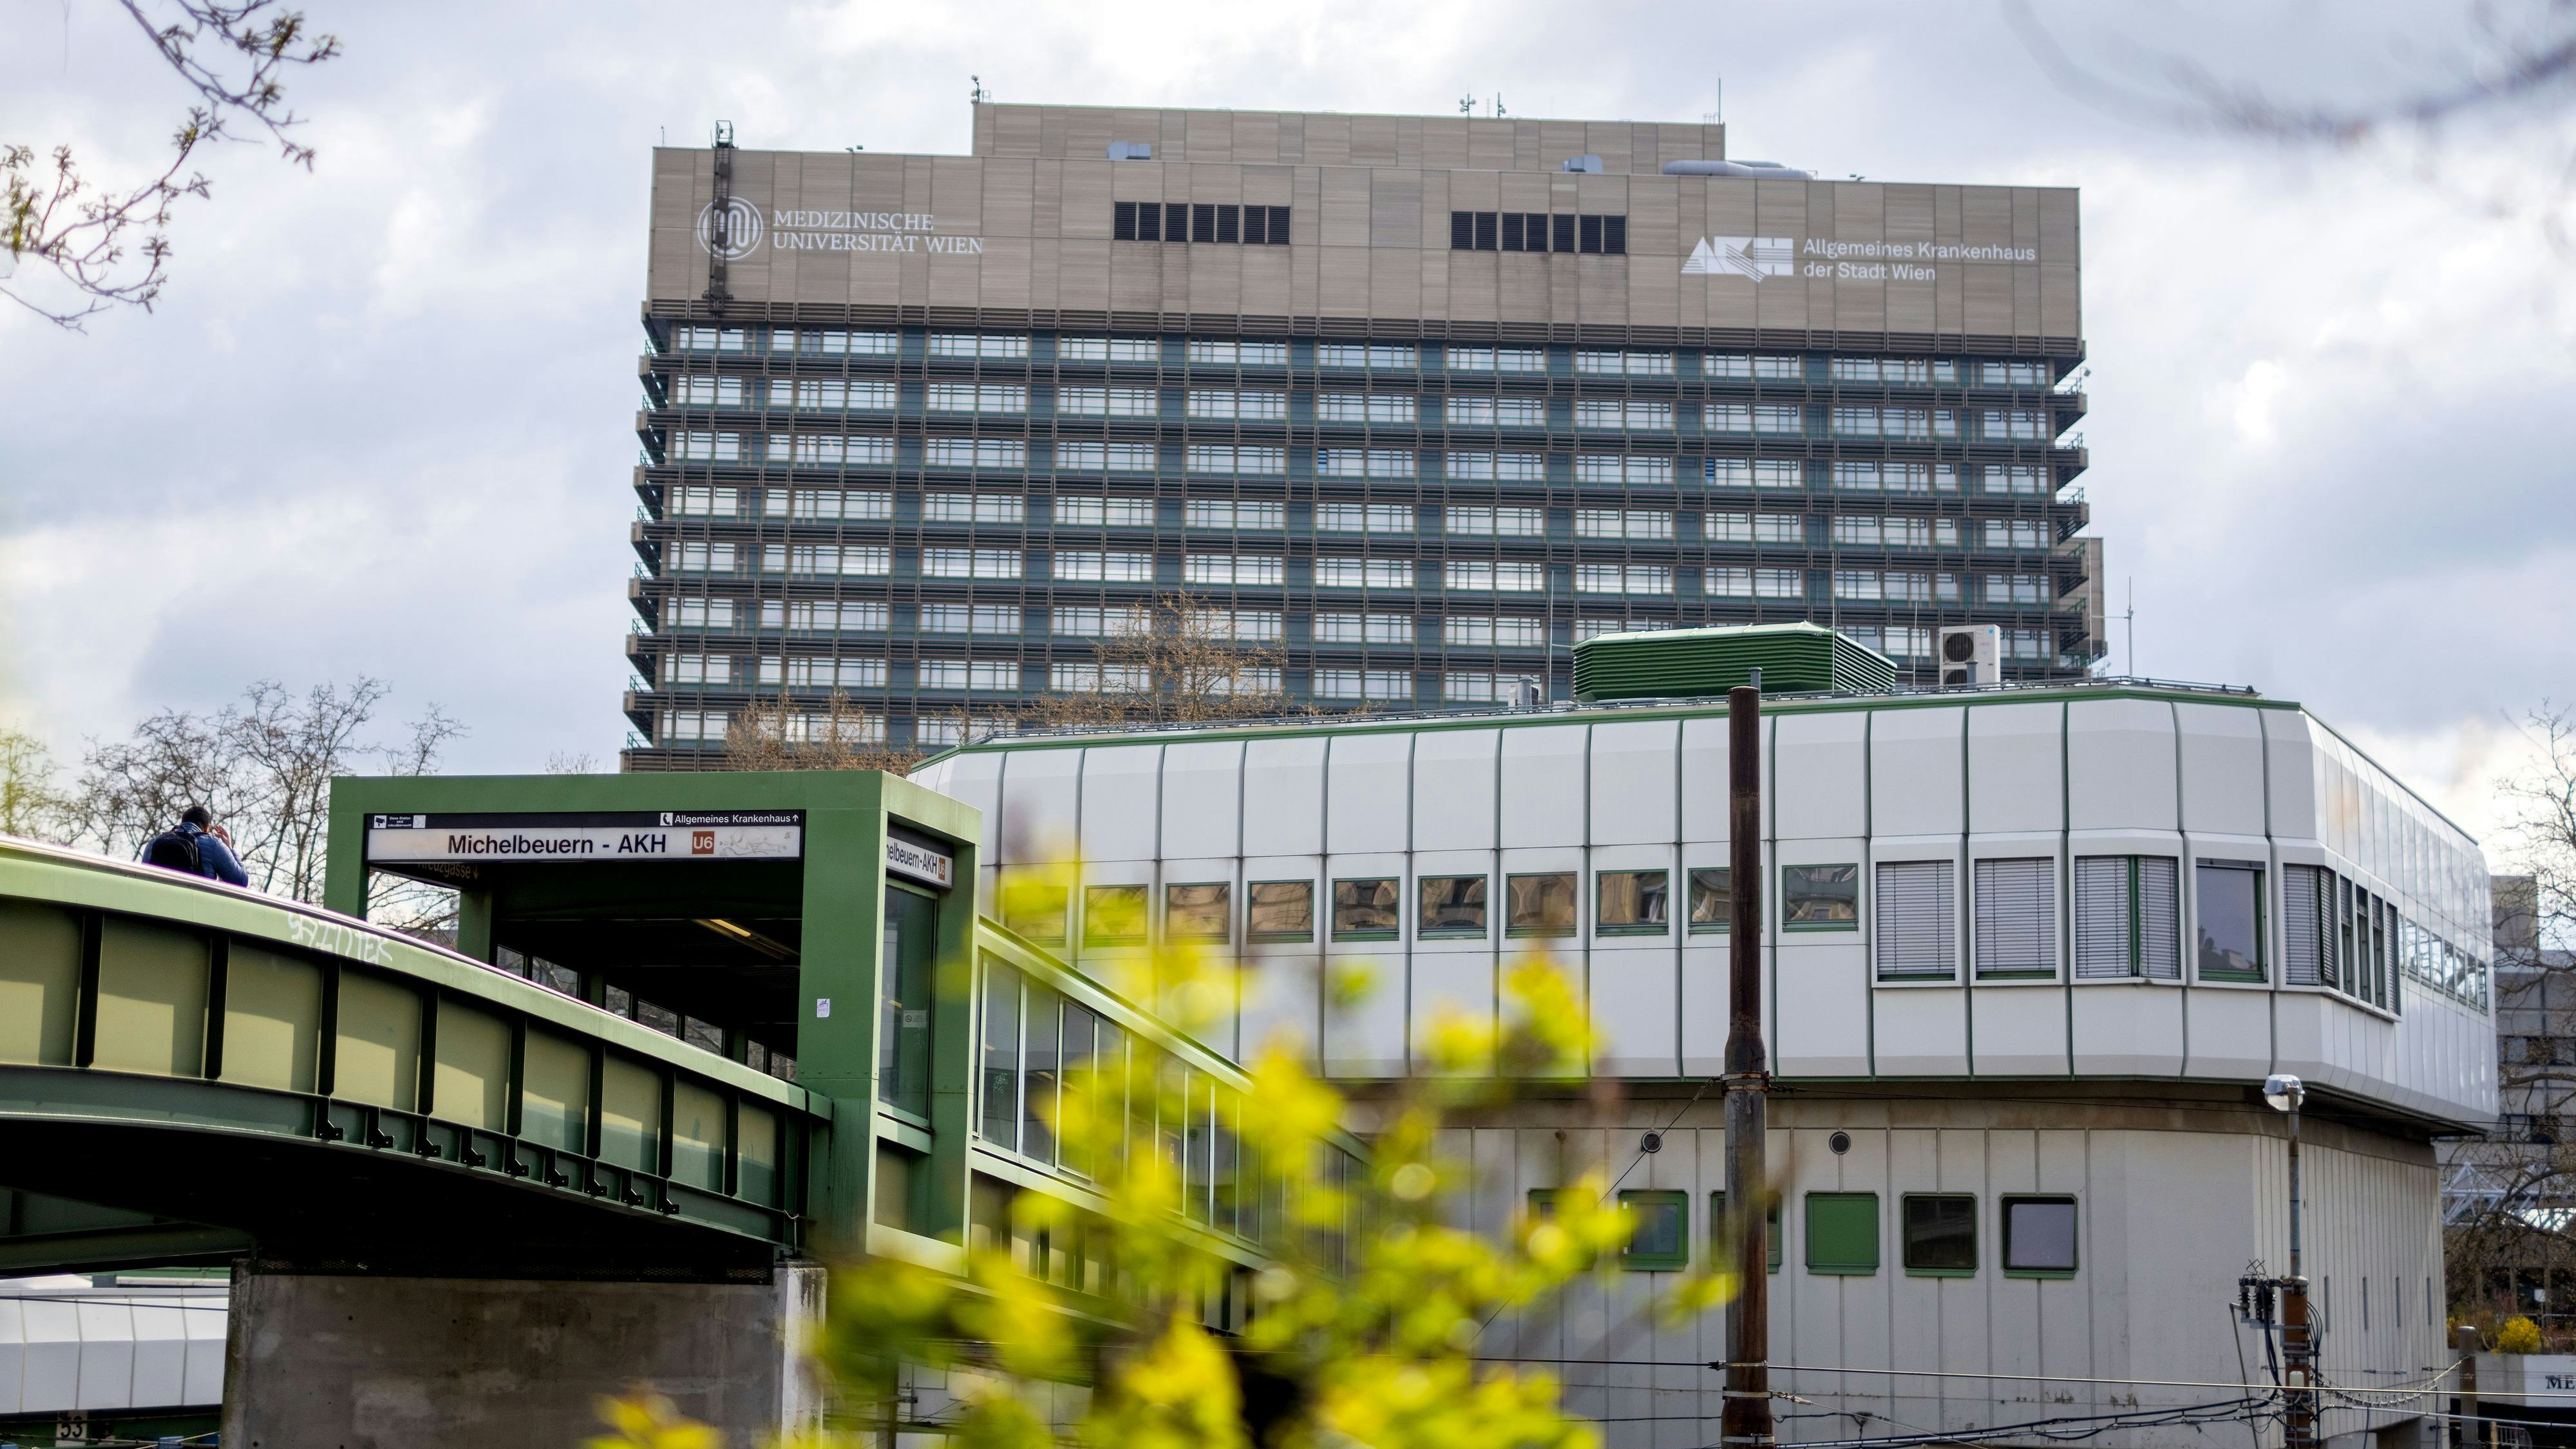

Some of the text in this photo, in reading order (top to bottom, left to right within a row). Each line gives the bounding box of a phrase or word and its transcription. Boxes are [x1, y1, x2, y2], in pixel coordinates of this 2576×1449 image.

[773, 210, 934, 231] MEDIZINISCHE
[773, 231, 985, 254] UNIVERSITÄT WIEN
[1803, 238, 2036, 261] Allgemeines Krankenhaus
[1804, 261, 1936, 281] der Stadt Wien
[674, 814, 791, 824] Allgemeines Krankenhaus
[448, 834, 593, 854] Michelbeuern
[618, 834, 667, 853] AKH
[693, 836, 714, 849] U6
[922, 853, 938, 875] AKH
